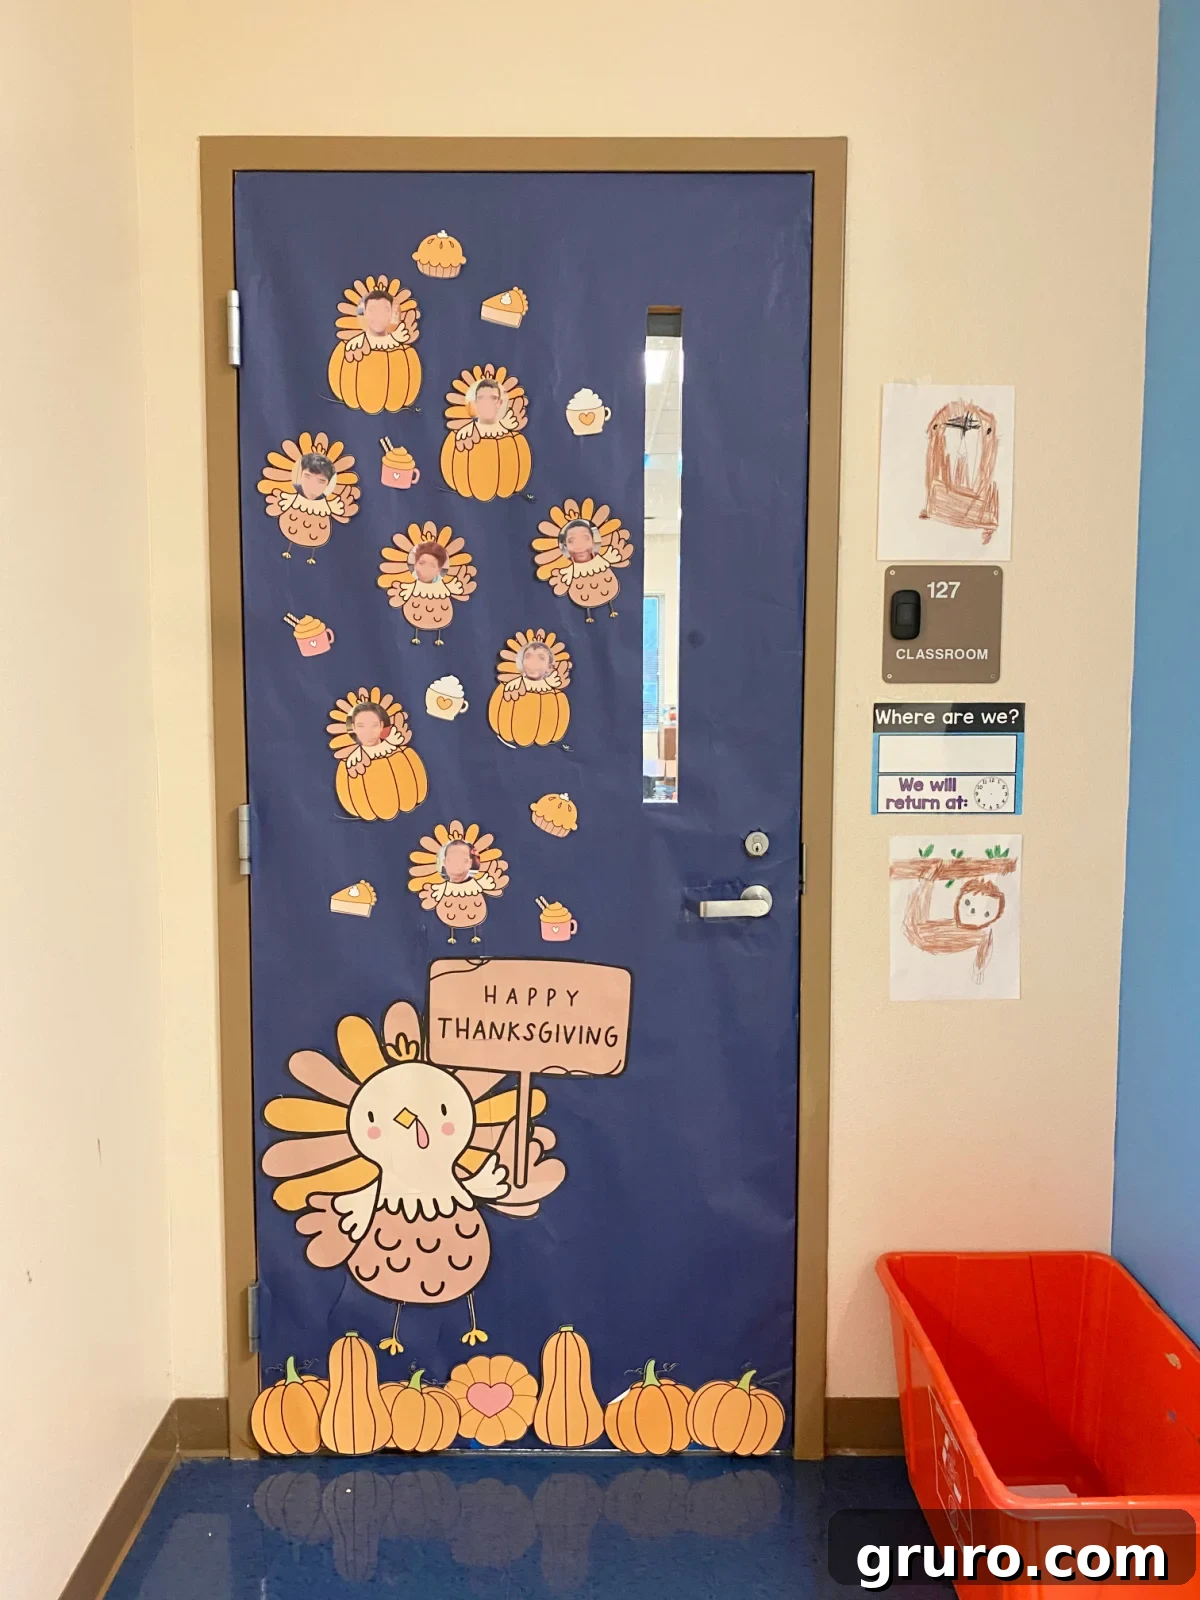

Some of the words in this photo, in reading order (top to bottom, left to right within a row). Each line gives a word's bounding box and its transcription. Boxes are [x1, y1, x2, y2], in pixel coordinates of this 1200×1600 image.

[927, 581, 961, 599] 127
[895, 648, 989, 660] CLASSROOM
[875, 708, 936, 725] Where
[942, 711, 975, 725] are
[981, 708, 1020, 725] we?
[898, 777, 924, 792] We
[929, 777, 957, 792] will
[885, 795, 940, 810] return
[945, 795, 968, 810] at:
[484, 985, 580, 1007] HAPPY
[437, 1017, 619, 1048] THANKSGIVING
